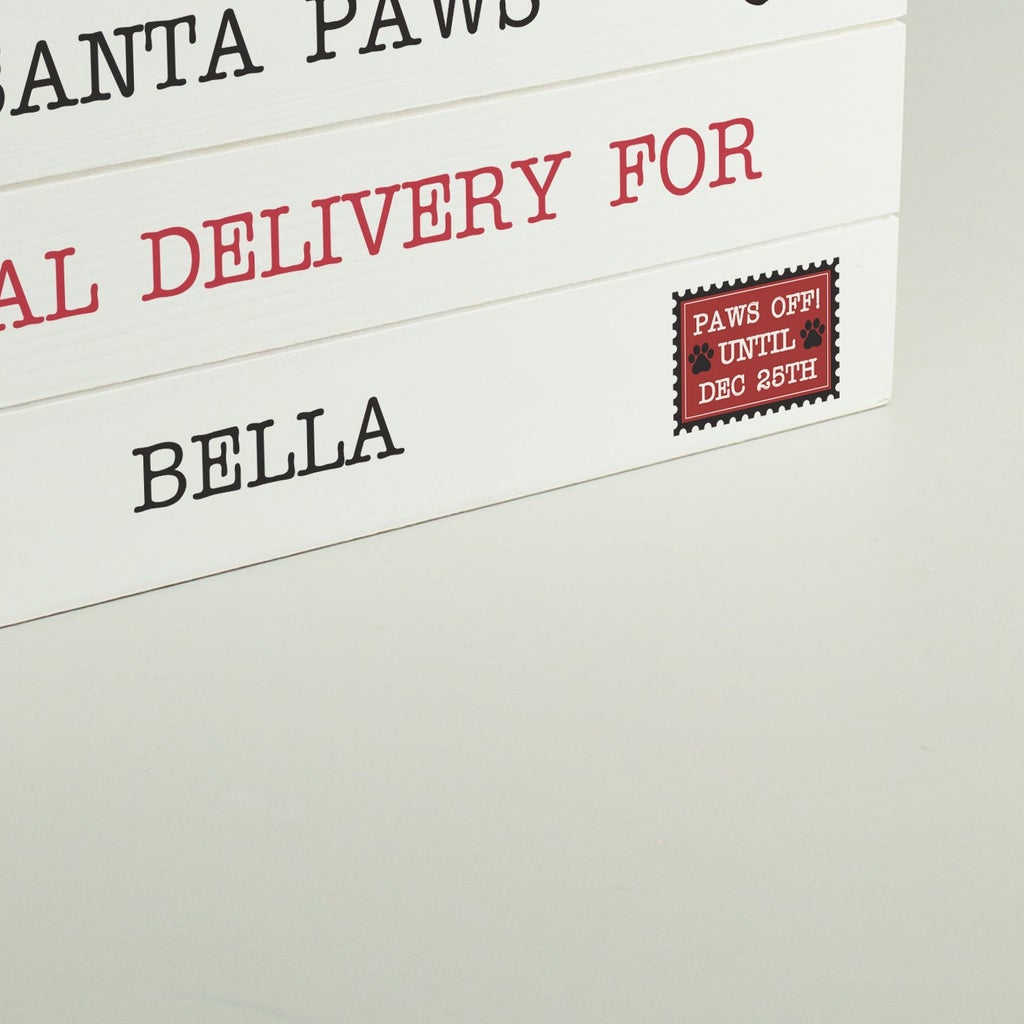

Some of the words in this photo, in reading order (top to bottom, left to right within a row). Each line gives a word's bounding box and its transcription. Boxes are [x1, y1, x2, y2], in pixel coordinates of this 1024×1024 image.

[141, 151, 571, 301] DELIVERY
[610, 118, 762, 207] FOR
[693, 301, 760, 336] PAWS
[771, 287, 821, 319] OFF!
[718, 328, 796, 365] UNTIL
[698, 374, 746, 405] DEC
[756, 357, 818, 392] 25TH
[132, 397, 405, 513] BELLA
